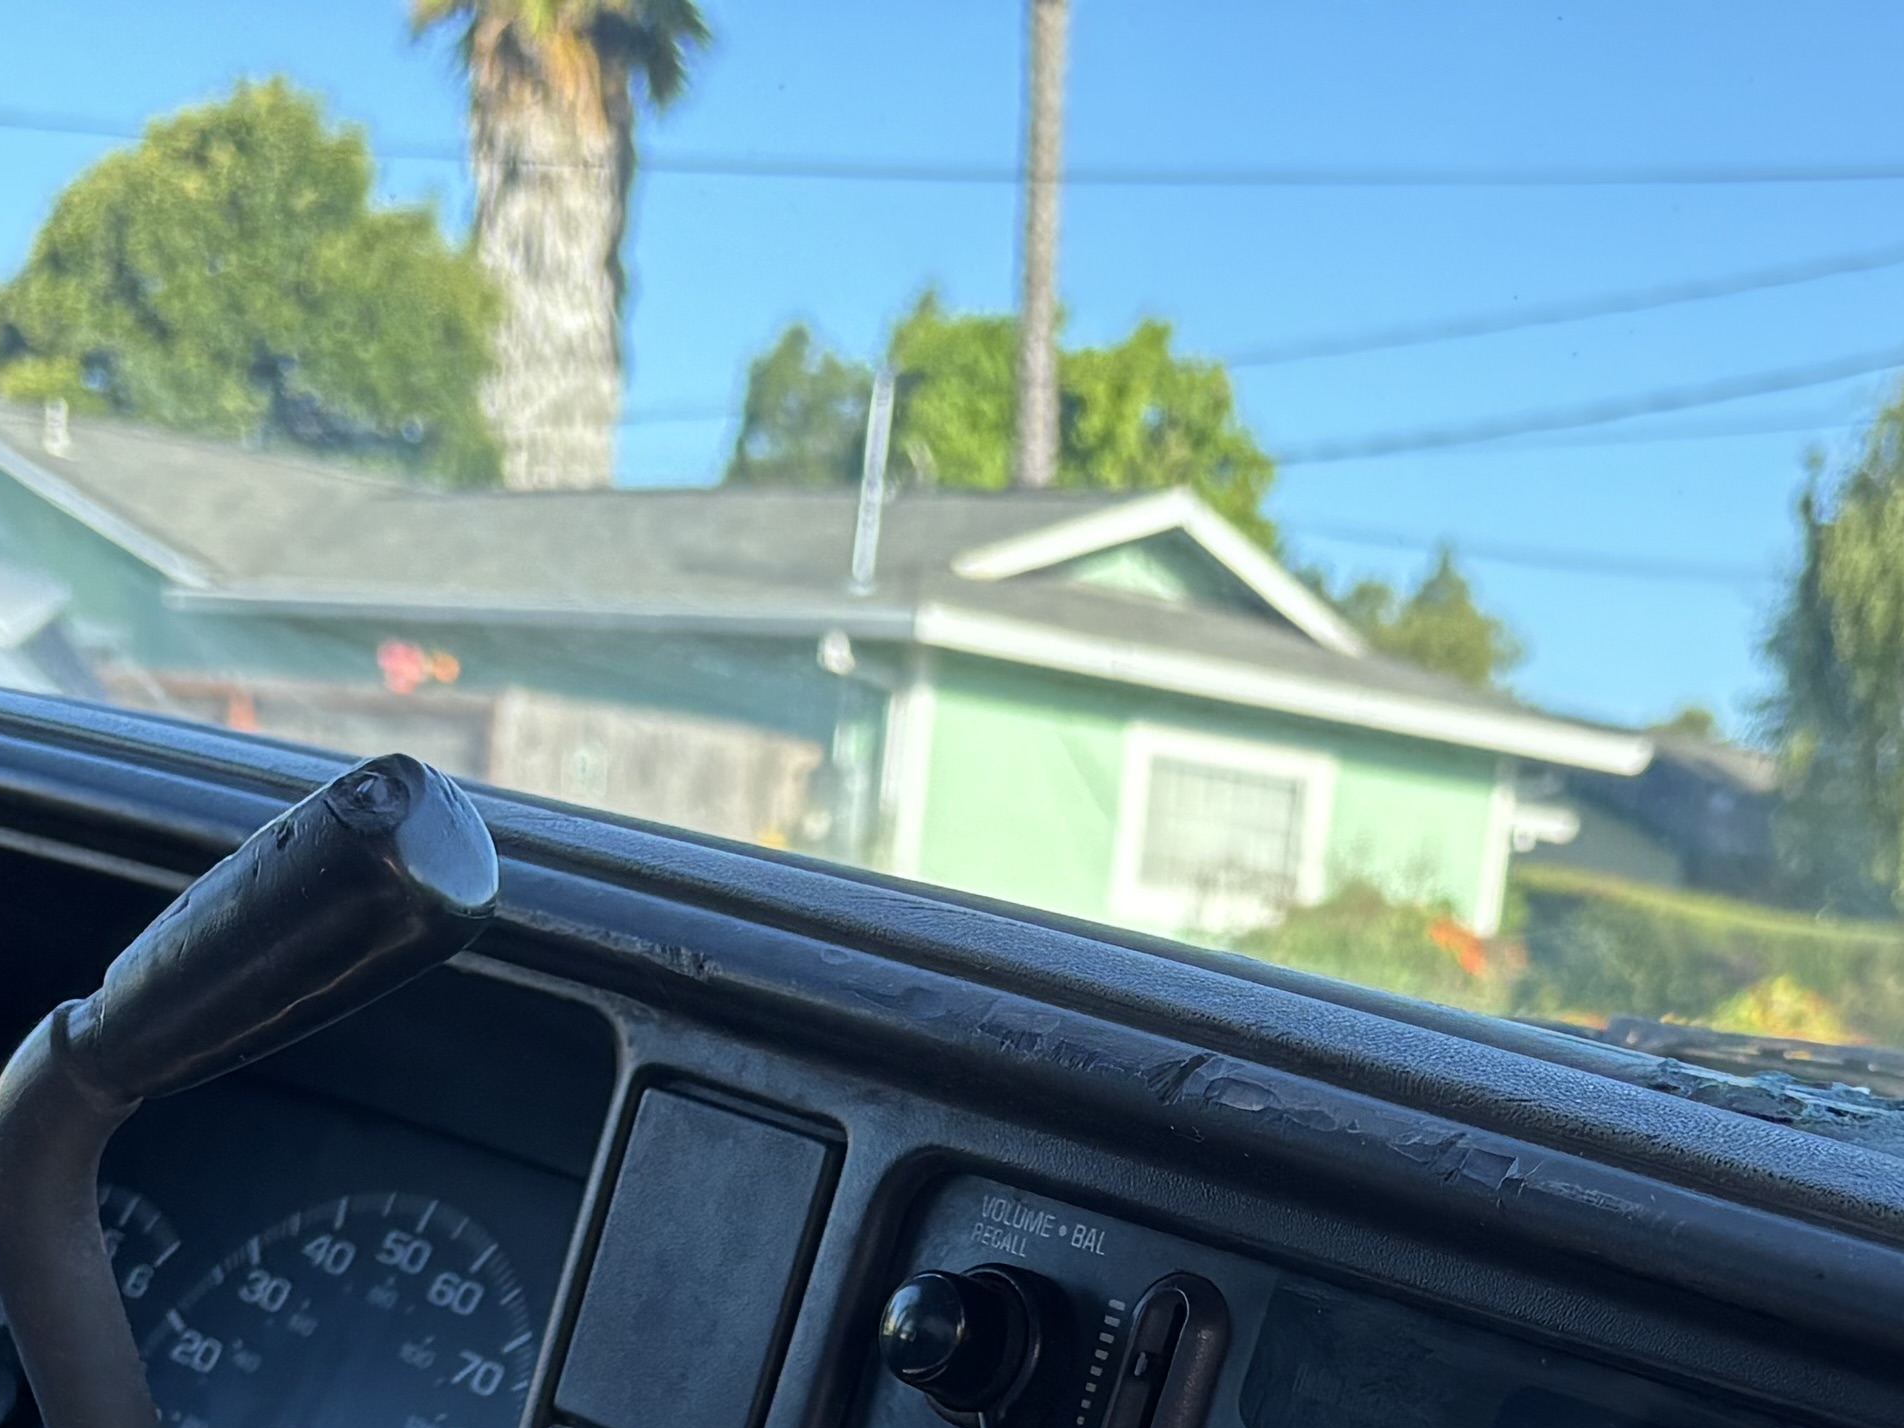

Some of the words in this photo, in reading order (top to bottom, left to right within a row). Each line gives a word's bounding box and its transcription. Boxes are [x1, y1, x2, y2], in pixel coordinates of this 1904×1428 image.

[971, 1222, 1027, 1258] RECALL
[981, 1194, 1056, 1239] VOLUME
[1070, 1222, 1107, 1257] BAL
[301, 1232, 357, 1276] 40
[374, 1228, 433, 1275] 50
[237, 1268, 292, 1313] 30
[426, 1270, 485, 1316] 60
[168, 1328, 223, 1374] 20
[449, 1349, 505, 1397] 70
